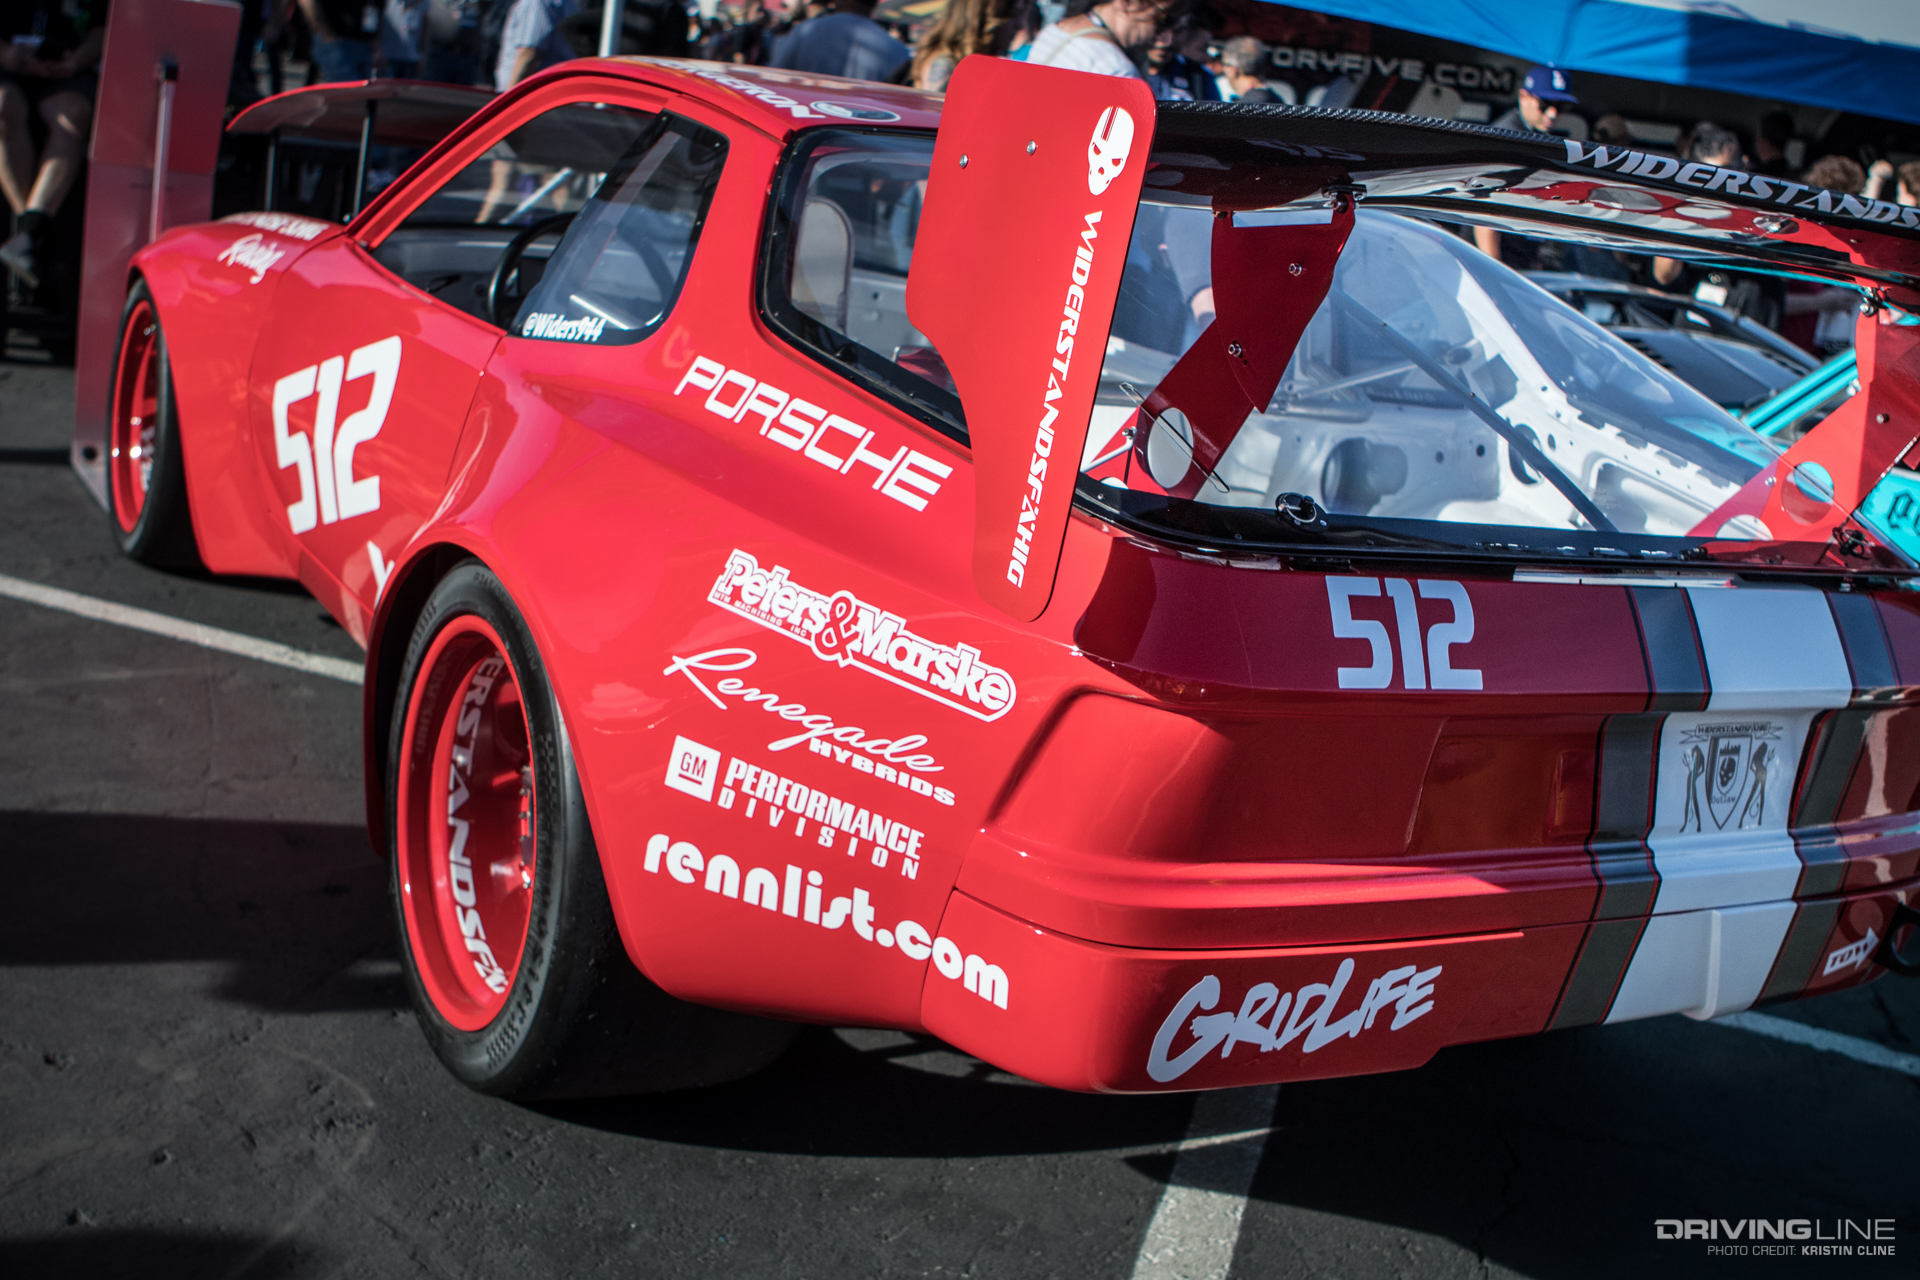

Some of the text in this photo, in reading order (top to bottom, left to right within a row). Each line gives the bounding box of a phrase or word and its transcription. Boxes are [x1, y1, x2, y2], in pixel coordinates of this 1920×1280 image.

[1563, 138, 1920, 231] WIDERSTANDS
[522, 312, 607, 343] @Widers944
[272, 335, 402, 535] 512
[673, 355, 953, 513] PORSCHE
[713, 591, 808, 638] MTM MACHINING INC
[1325, 575, 1484, 691] 512
[663, 648, 945, 772] Renegade
[680, 751, 708, 780] GM
[723, 756, 926, 860] PERFORMANCE
[808, 736, 956, 807] HYBRIDS
[717, 786, 920, 881] DIVISION
[643, 833, 1010, 1011] rennlist.com
[1829, 941, 1869, 969] TOW
